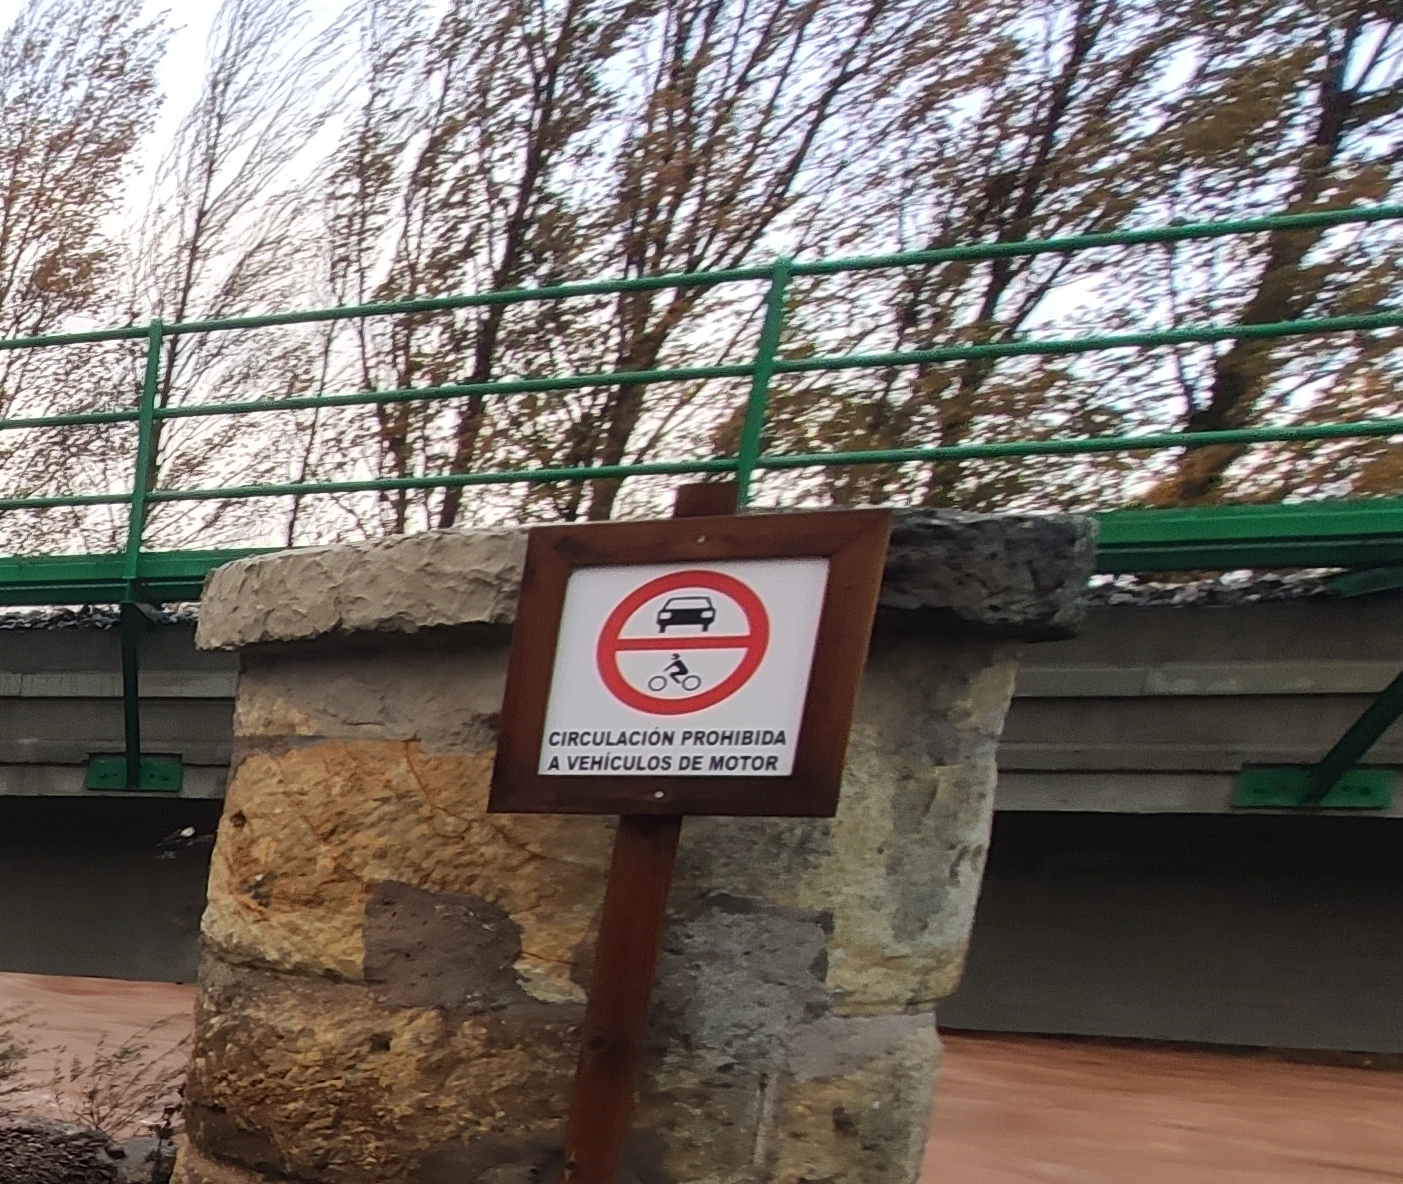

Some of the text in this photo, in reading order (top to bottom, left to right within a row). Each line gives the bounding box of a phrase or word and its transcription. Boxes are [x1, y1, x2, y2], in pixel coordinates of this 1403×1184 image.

[548, 727, 787, 747] CIRCULACIÓN PROHIBIDA
[547, 751, 780, 772] A VEHÍCULOS DE MOTOR
